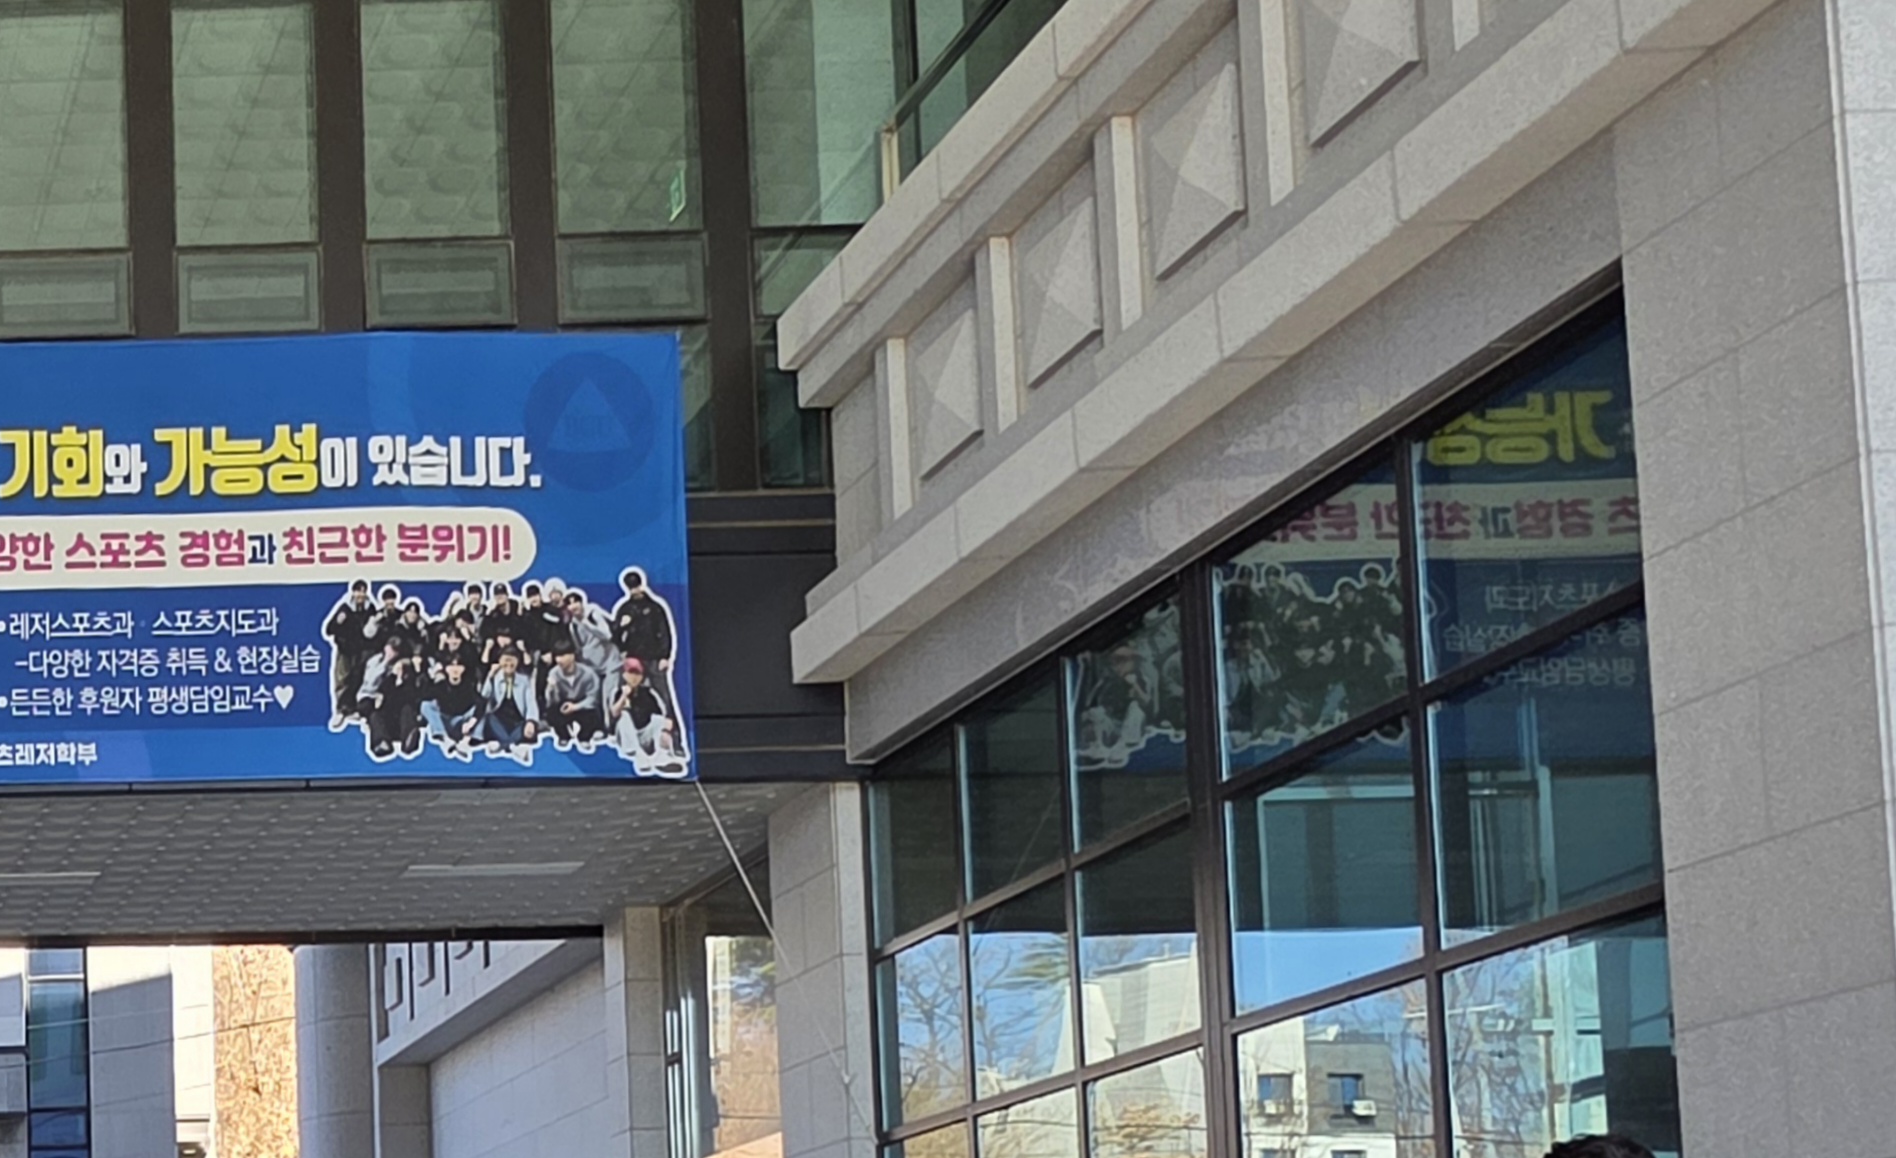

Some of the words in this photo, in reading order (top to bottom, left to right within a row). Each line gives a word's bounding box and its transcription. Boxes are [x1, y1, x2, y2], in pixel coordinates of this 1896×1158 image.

[153, 423, 358, 496] 가능성이
[367, 434, 542, 488] 있습니다.
[64, 529, 166, 571] 스포츠
[179, 528, 277, 568] 경험과
[282, 521, 386, 566] 친근한
[397, 522, 512, 563] 분위기!
[8, 610, 135, 641] 레저스포츠과
[151, 606, 279, 637] 스포츠지도과
[95, 646, 161, 678] 자격증
[165, 646, 209, 677] 취득
[213, 646, 233, 674] &
[236, 643, 322, 675] 현장실습
[9, 687, 73, 718] 든든한
[77, 685, 143, 717] 후원자
[147, 683, 274, 714] 평생담임교수
